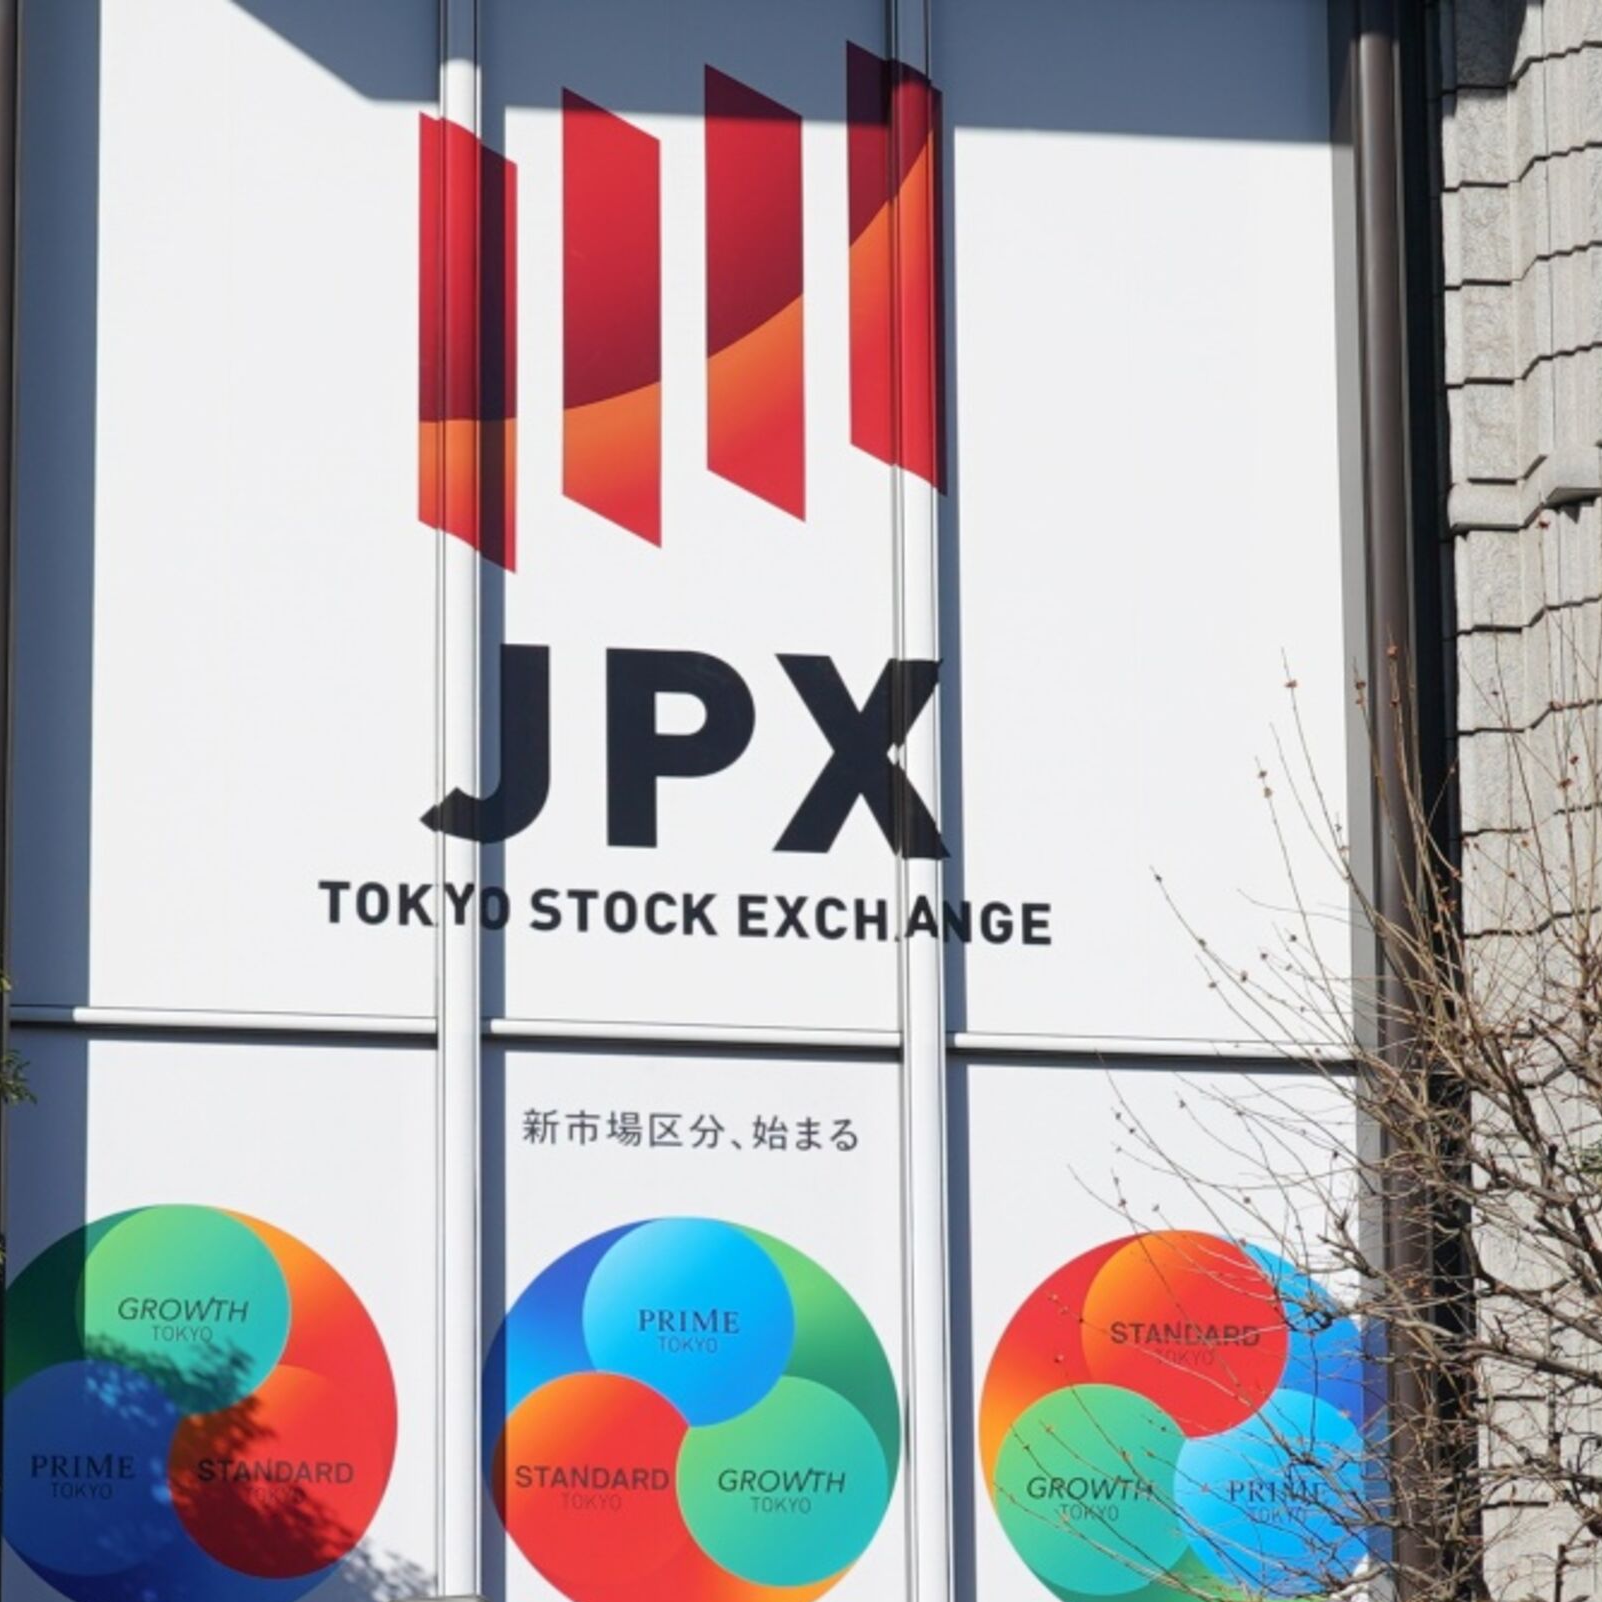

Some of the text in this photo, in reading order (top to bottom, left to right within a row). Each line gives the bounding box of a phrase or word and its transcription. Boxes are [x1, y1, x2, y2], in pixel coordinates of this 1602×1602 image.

[420, 643, 951, 860] JPX
[318, 880, 1052, 945] TOKYO STOCK EXCHANGE
[522, 1108, 858, 1152] 新市場区分、始まる
[117, 1297, 250, 1322] GROWTH
[638, 1308, 740, 1334] PRIME
[152, 1325, 214, 1343] TOKYO
[658, 1336, 718, 1354] TOKYO
[1109, 1320, 1261, 1347] STANDARD
[30, 1453, 136, 1480] PRIME
[197, 1457, 355, 1485] STANDARD
[514, 1465, 670, 1491] STANDARD
[50, 1481, 113, 1500] TOKYO
[717, 1467, 846, 1494] GROWTH
[561, 1493, 623, 1511] TOKYO
[750, 1496, 812, 1514] TOKYO
